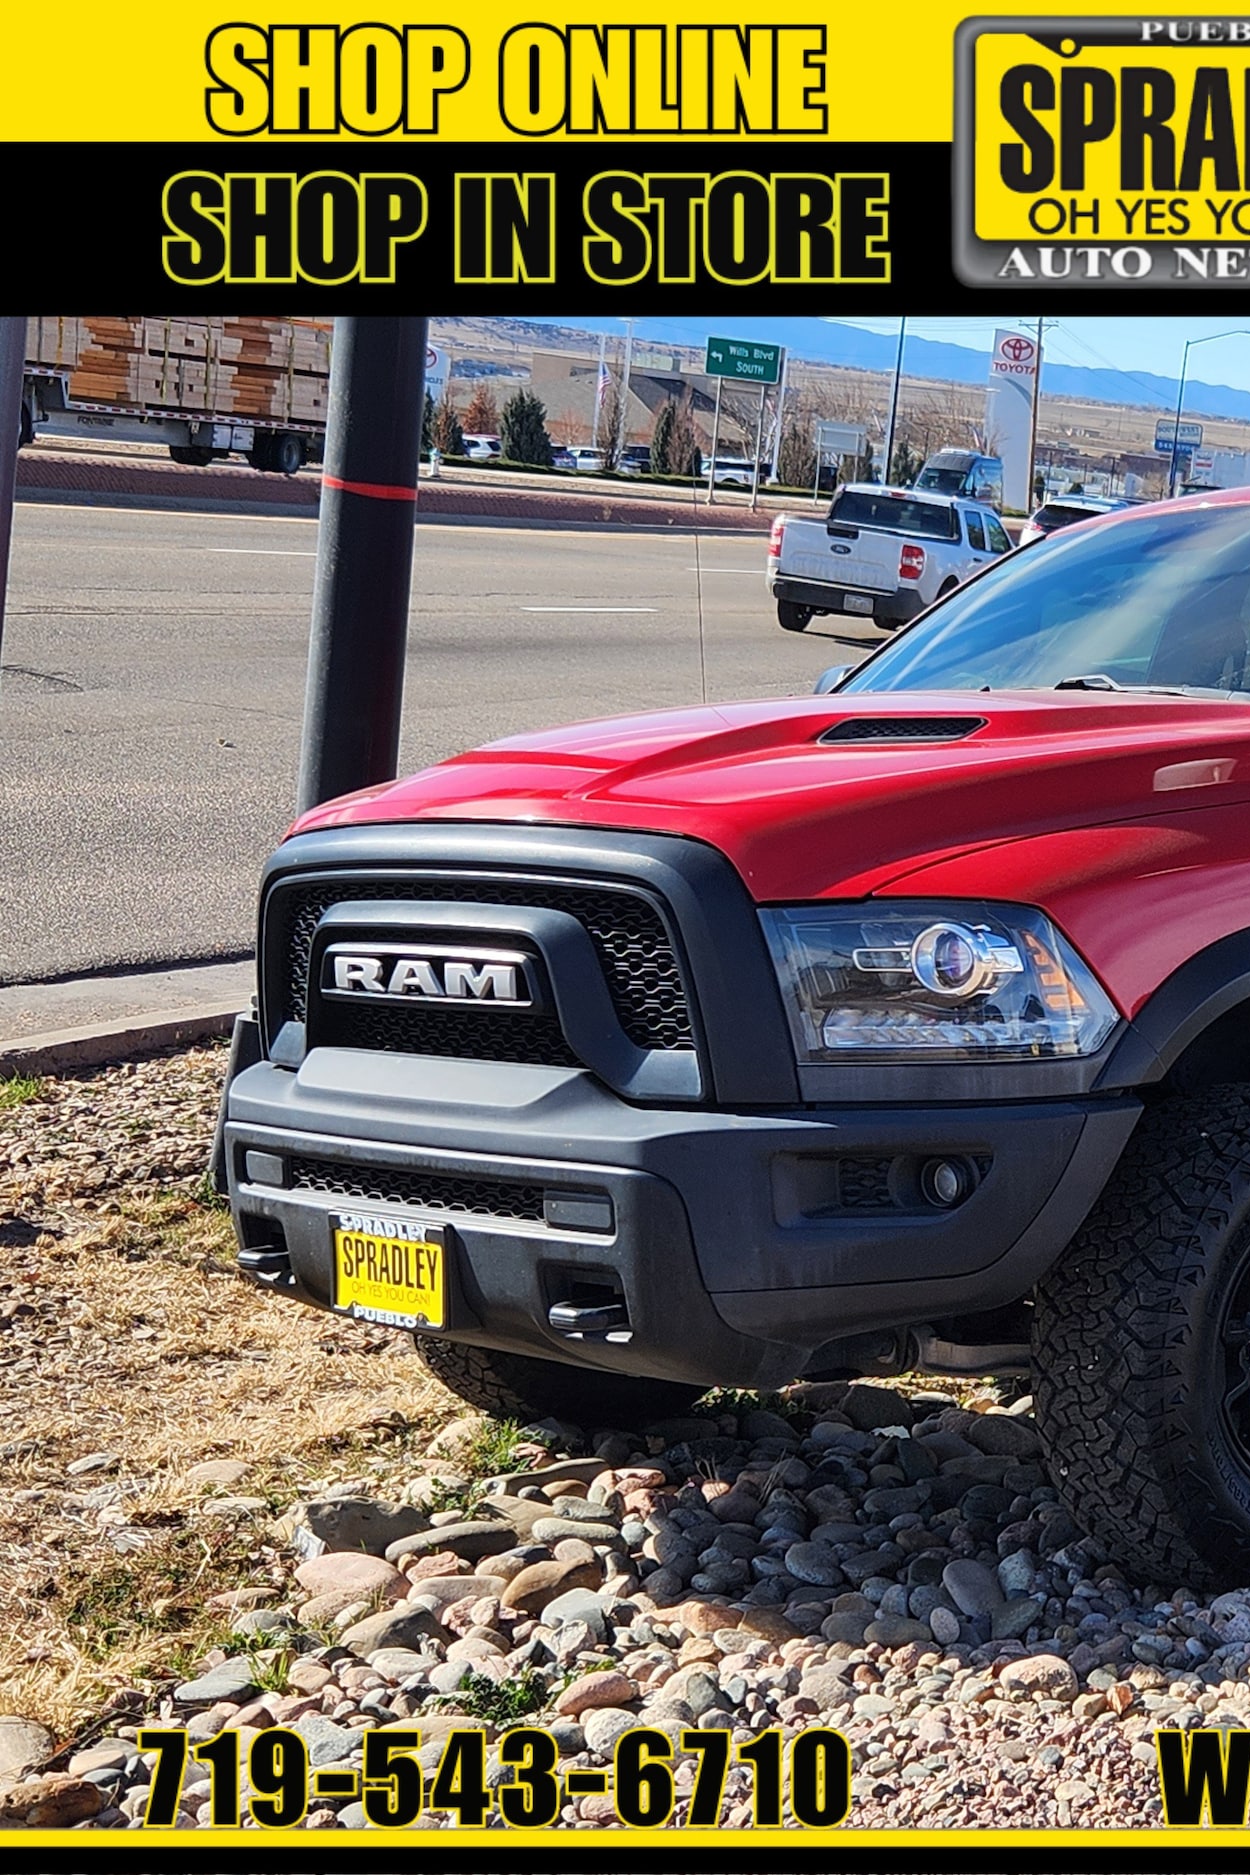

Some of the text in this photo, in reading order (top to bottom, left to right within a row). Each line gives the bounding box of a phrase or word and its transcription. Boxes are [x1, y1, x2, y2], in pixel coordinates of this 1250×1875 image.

[735, 361, 765, 375] SOUTH
[334, 956, 517, 1001] RAM
[339, 1214, 428, 1242] SPRADLEY
[342, 1235, 438, 1292] SPRADLEY
[352, 1281, 366, 1295] OH
[368, 1283, 382, 1298] YES
[384, 1287, 405, 1302] YOU
[353, 1304, 418, 1328] PUEBLO
